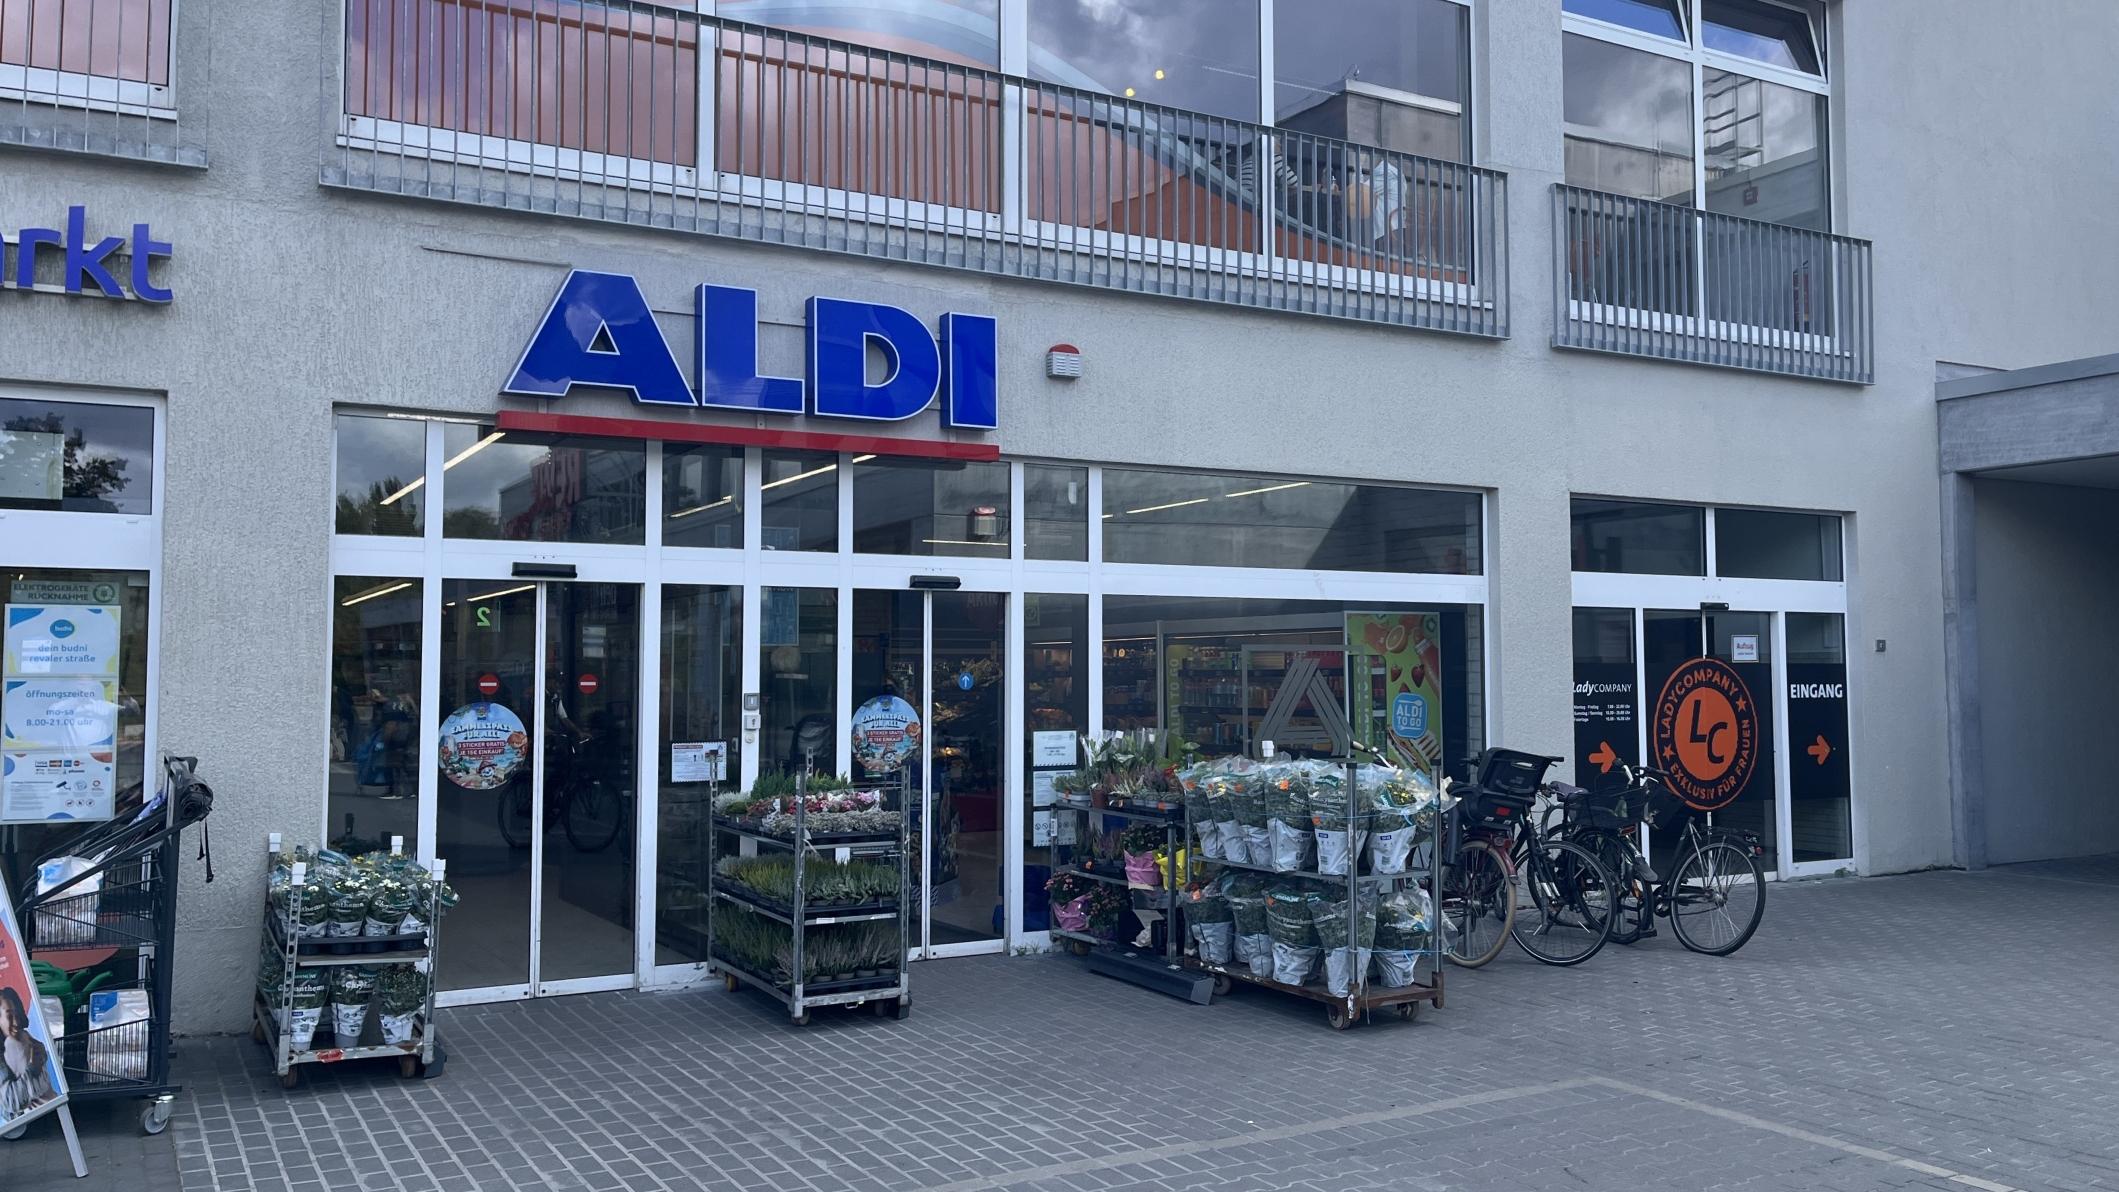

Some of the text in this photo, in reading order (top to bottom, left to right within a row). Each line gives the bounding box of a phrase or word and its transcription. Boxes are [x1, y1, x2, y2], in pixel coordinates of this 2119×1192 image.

[0, 205, 173, 302] rkt
[500, 268, 998, 431] ALDI
[38, 644, 88, 652] dein budni
[25, 689, 95, 699] öffnungszeiten
[1790, 684, 1843, 698] EINGANG
[1661, 669, 1738, 738] LADYCOMPANY
[1396, 704, 1423, 718] ALDI
[1396, 716, 1422, 727] TO GO
[1669, 719, 1751, 800] EXKLUSIV FÜR FRAUEN
